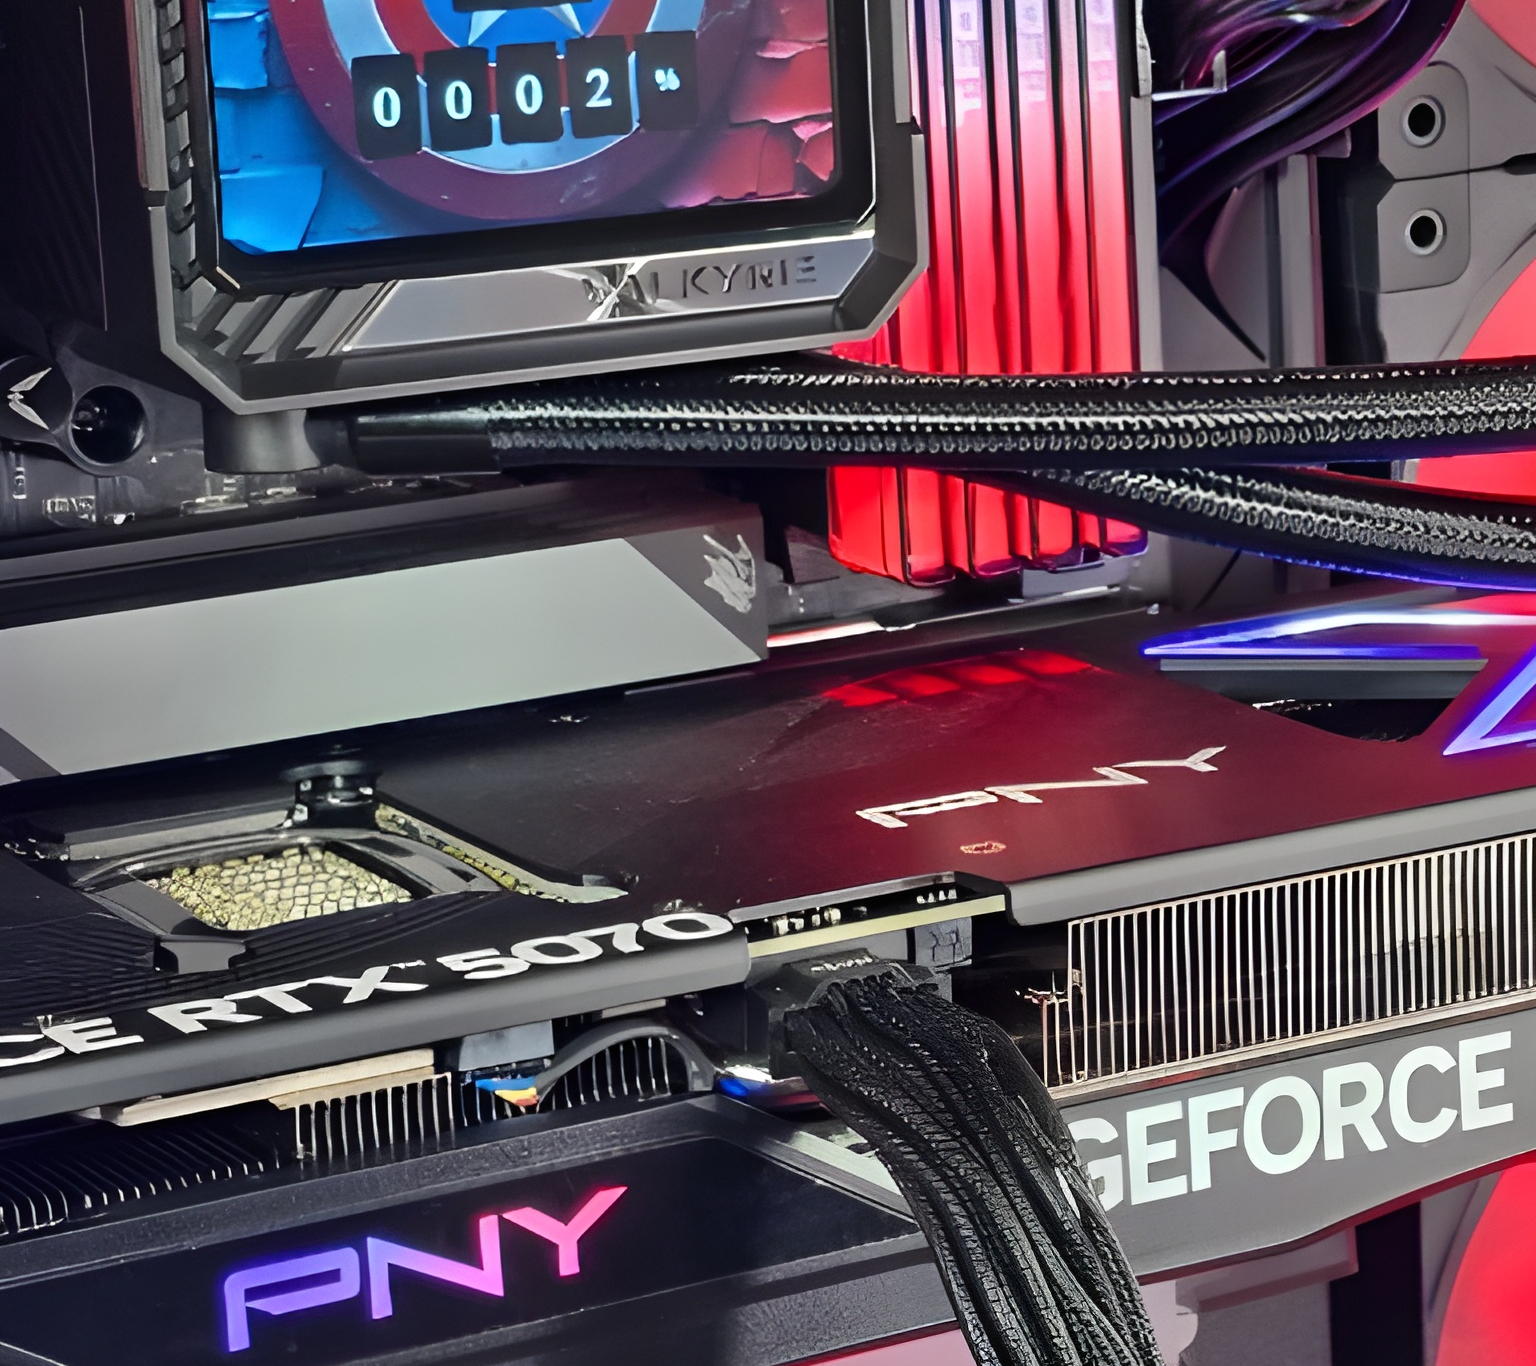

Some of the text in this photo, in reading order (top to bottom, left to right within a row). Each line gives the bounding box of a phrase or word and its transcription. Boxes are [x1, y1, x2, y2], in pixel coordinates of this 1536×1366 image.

[854, 745, 1228, 829] PNY
[435, 912, 734, 980] 5070
[1067, 1030, 1516, 1213] GEFORCE
[223, 1185, 629, 1353] PNY
